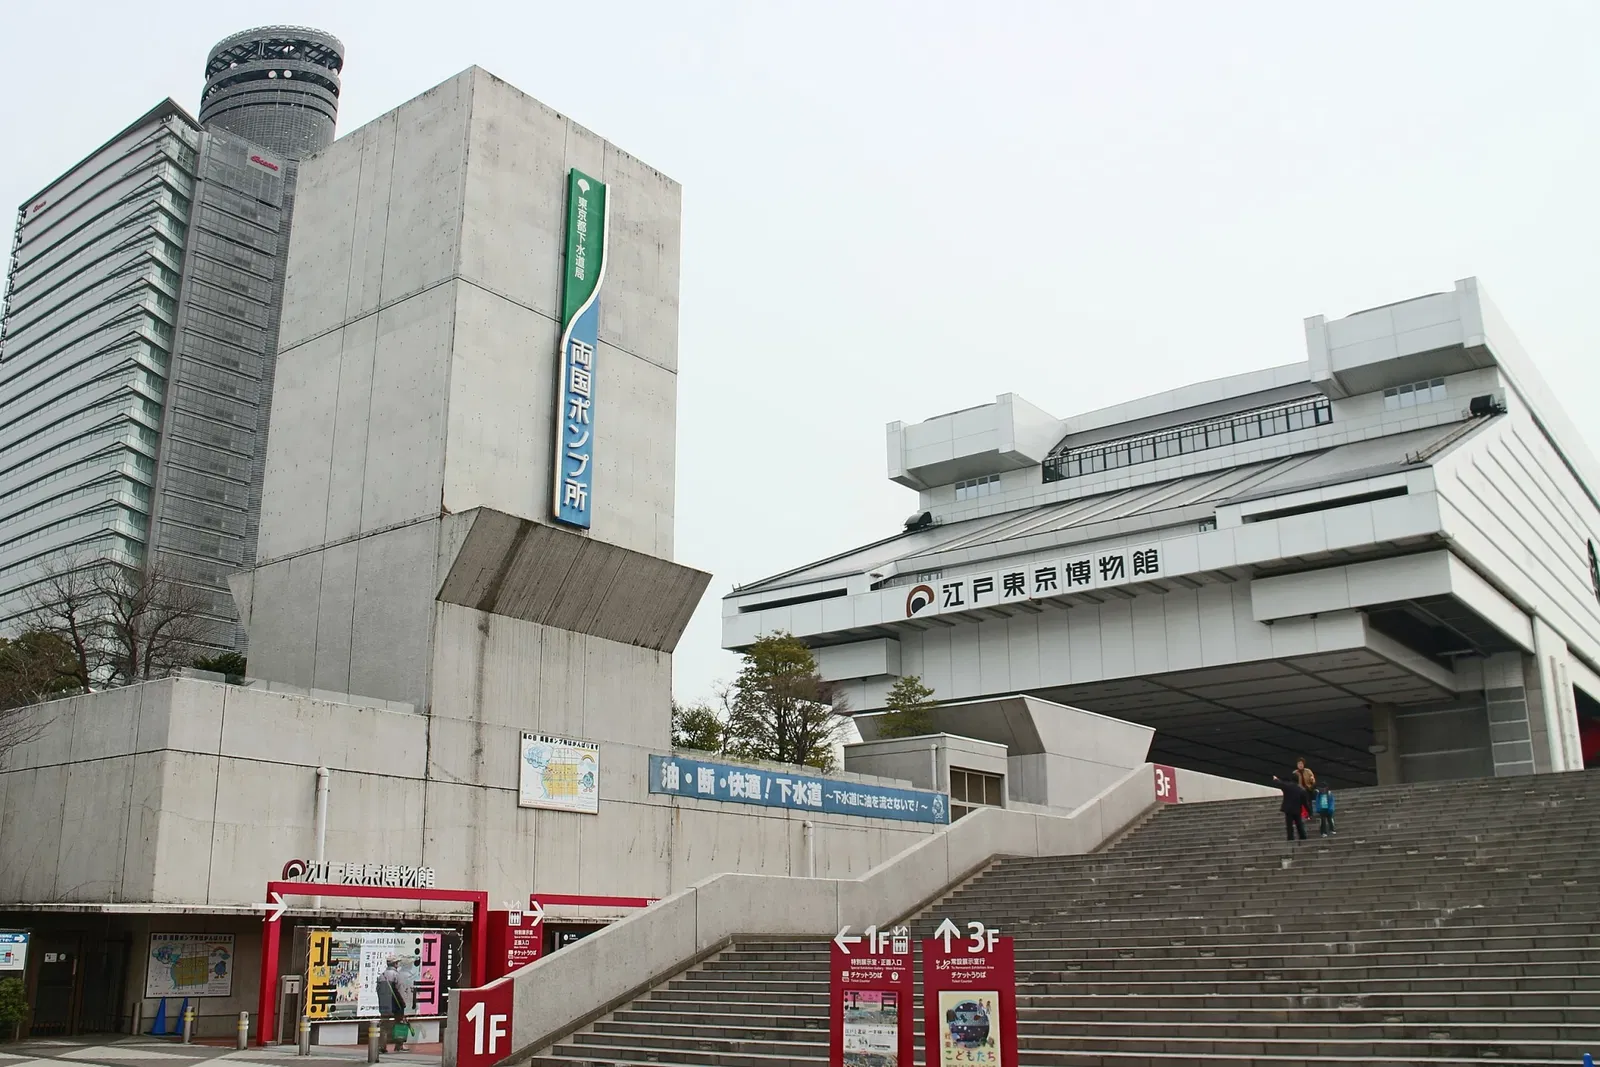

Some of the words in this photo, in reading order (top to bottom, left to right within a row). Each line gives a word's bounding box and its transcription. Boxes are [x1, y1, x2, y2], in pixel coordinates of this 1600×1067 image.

[574, 196, 588, 281] 東京都下水道局
[562, 337, 594, 513] 両国ポンプ所
[942, 547, 1160, 608] 江戸東京博物館
[1155, 768, 1171, 797] 3F
[306, 859, 436, 889] 江戸東京博物館
[864, 925, 890, 955] 1F
[967, 921, 999, 953] 3F
[951, 971, 987, 979] チケットうりば
[465, 1002, 507, 1055] 1F
[945, 1050, 996, 1063] こどもたち
